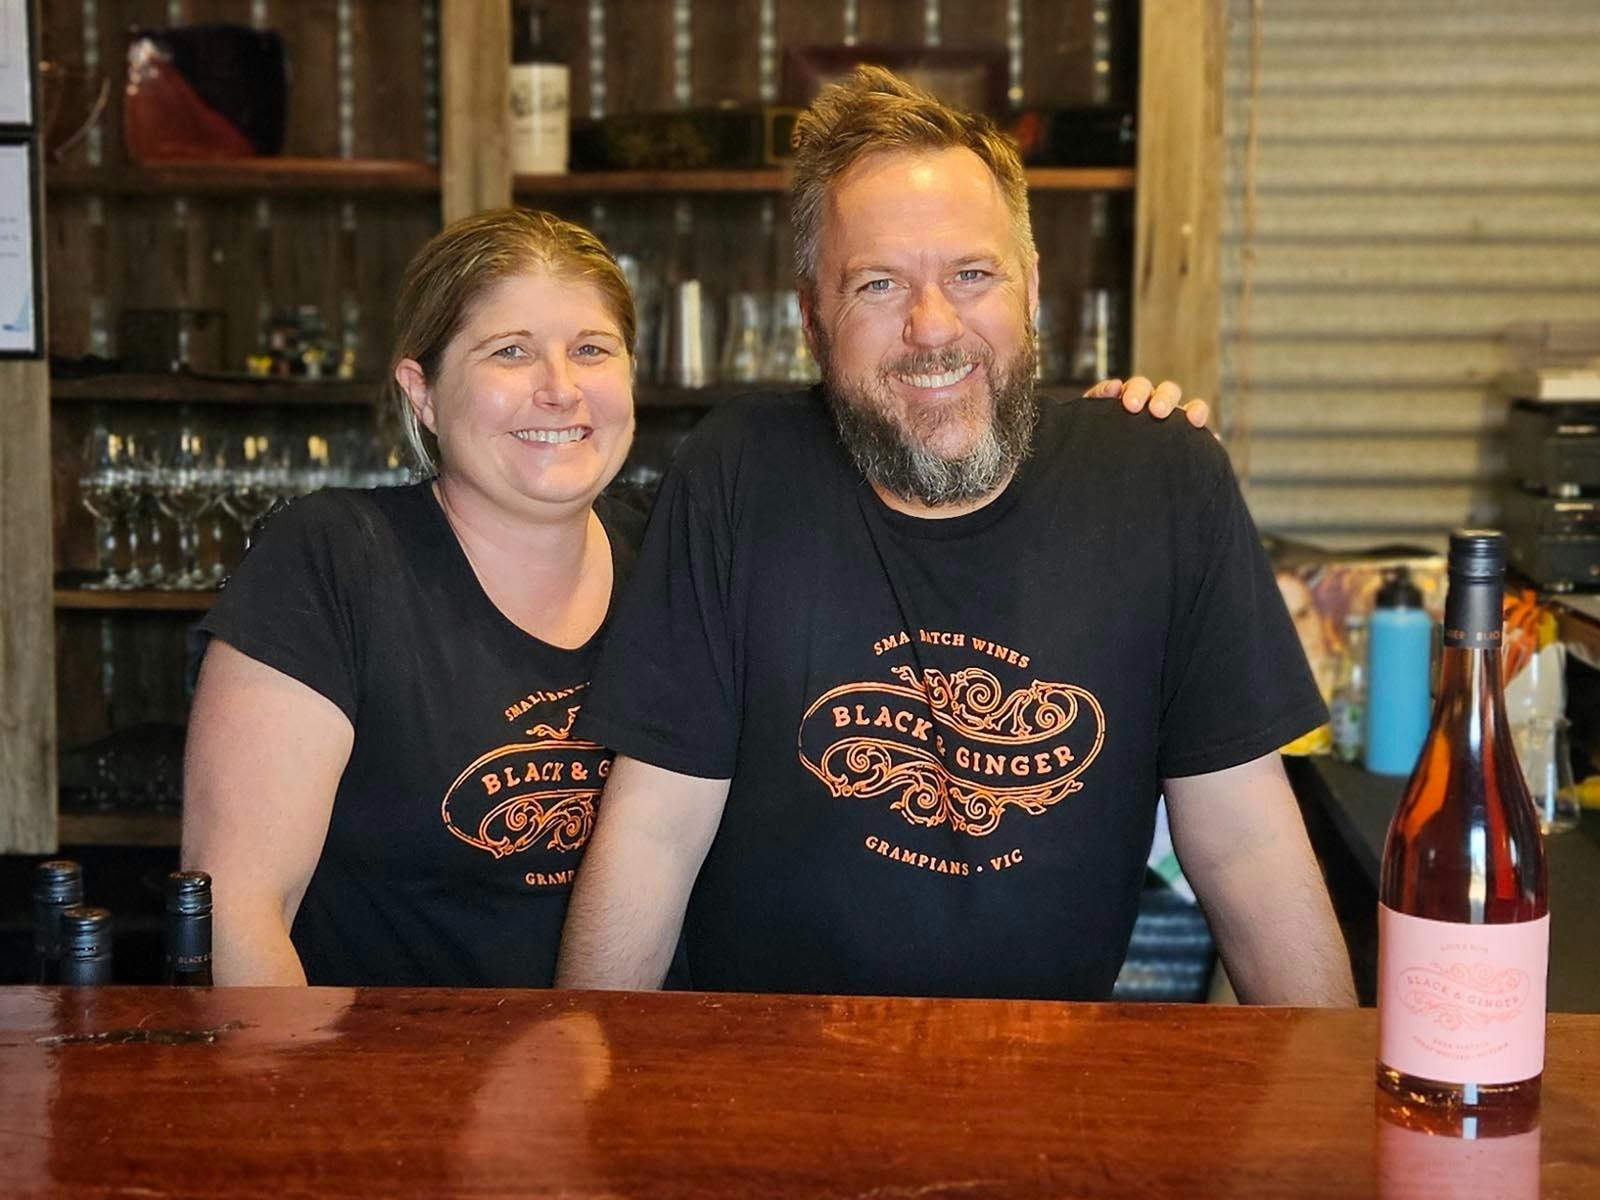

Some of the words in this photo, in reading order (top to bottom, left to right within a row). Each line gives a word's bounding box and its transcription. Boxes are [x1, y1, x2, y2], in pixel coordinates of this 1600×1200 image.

[873, 630, 911, 656] SMA
[971, 637, 1031, 668] WINES
[832, 704, 932, 741] BLACK
[956, 745, 1075, 776] GINGER
[481, 760, 564, 795] BLACK
[571, 761, 588, 780] &
[865, 835, 970, 876] GRAMPIANS
[990, 848, 1023, 872] VIC
[1406, 975, 1448, 994] BLACK
